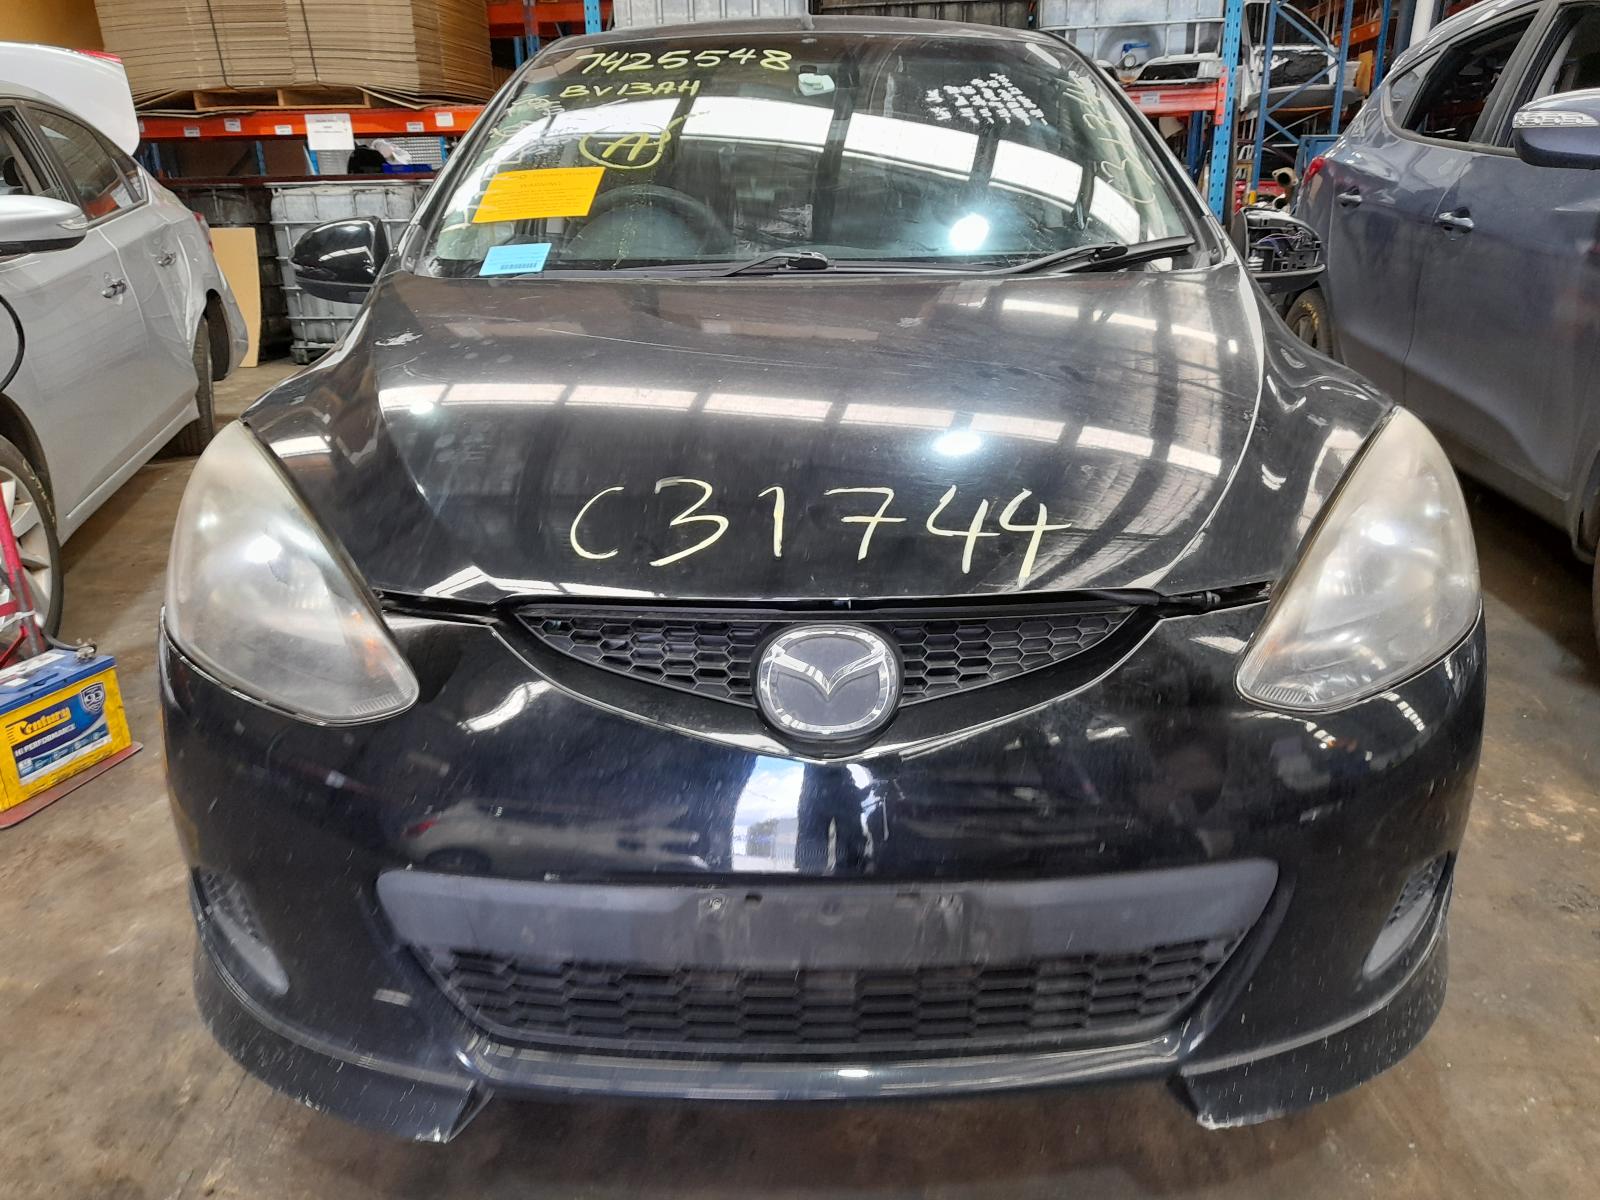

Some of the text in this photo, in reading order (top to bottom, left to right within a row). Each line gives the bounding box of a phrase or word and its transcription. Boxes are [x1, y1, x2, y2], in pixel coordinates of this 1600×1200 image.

[576, 48, 792, 74] 7425548
[560, 80, 700, 99] BV13AH
[570, 476, 1072, 588] C31744
[19, 706, 71, 736] Century
[24, 723, 76, 752] PERFORMANCE
